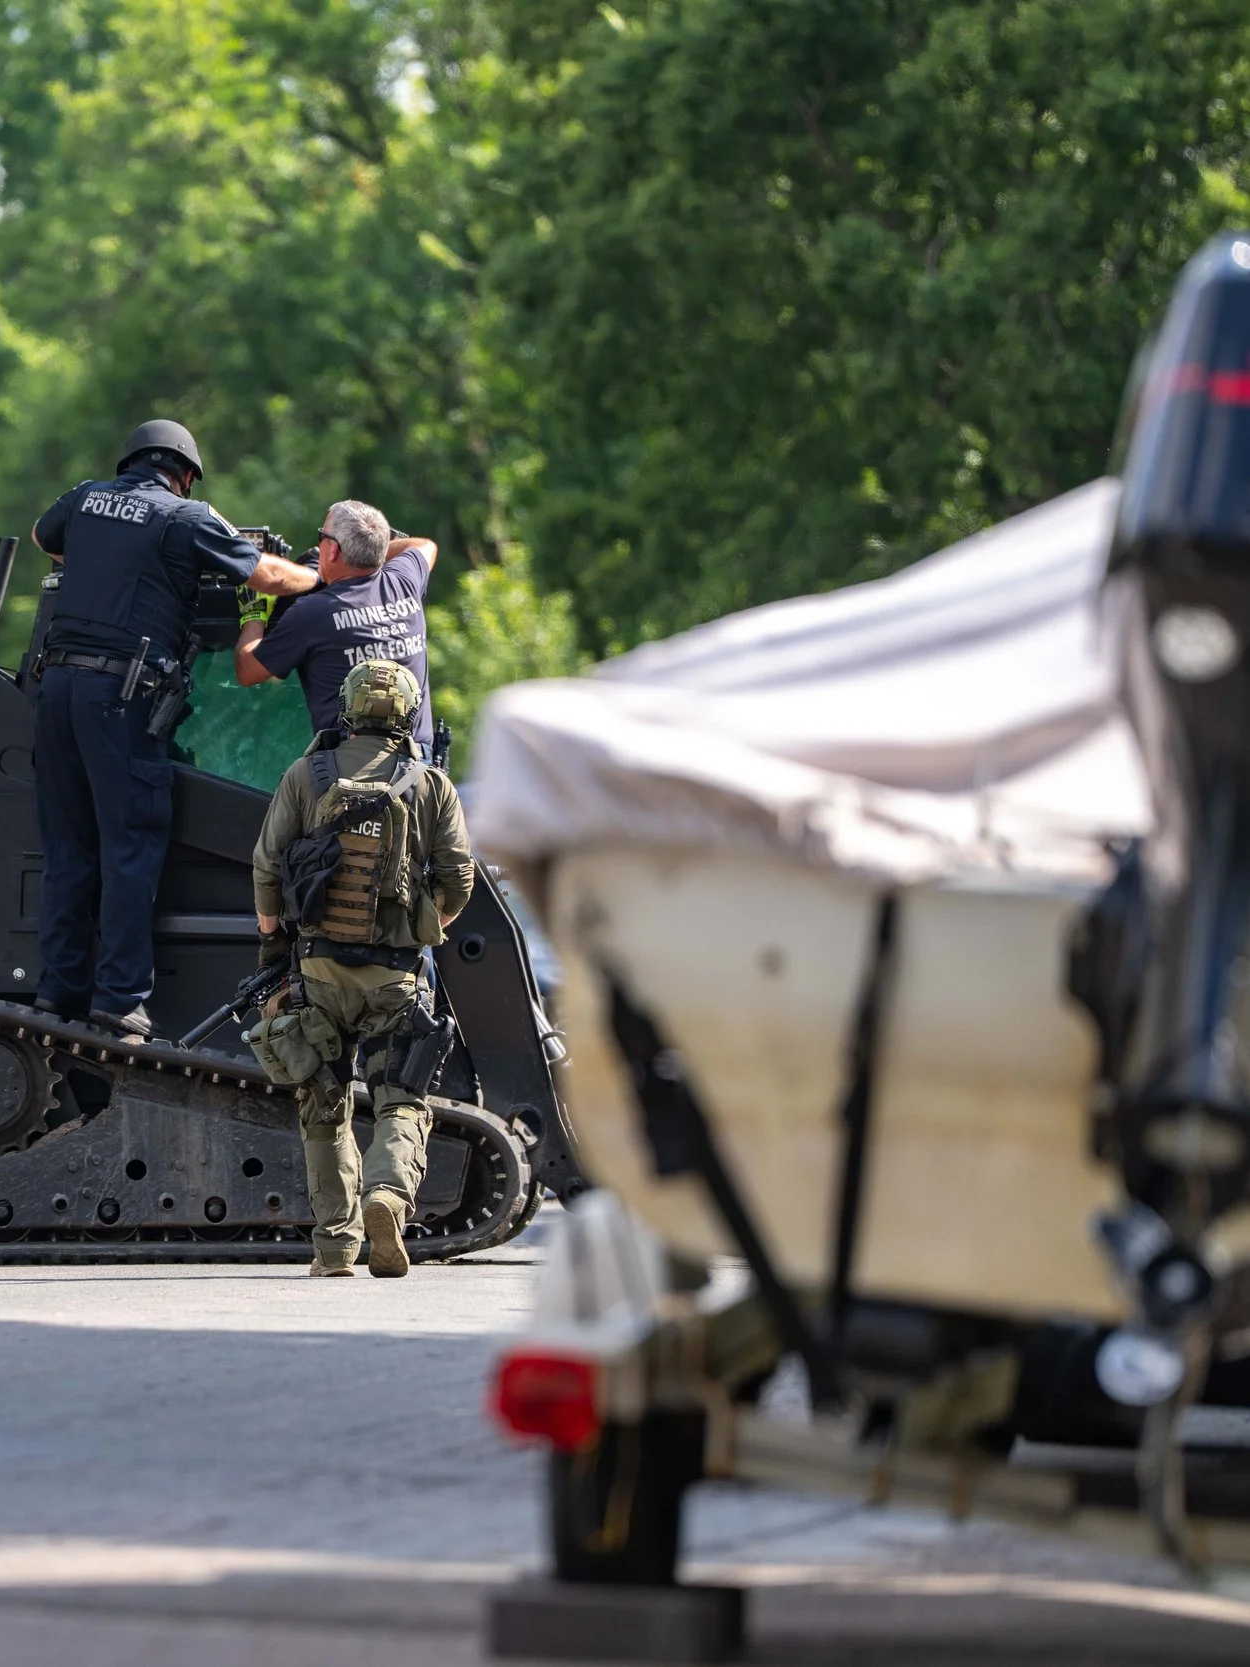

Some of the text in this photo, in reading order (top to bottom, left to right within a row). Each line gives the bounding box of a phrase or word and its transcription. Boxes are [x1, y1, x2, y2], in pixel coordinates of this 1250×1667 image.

[81, 497, 148, 524] POLICE
[87, 491, 149, 510] SOUTH ST. PAUL
[332, 596, 421, 631] MINNESOTA
[371, 622, 409, 638] US&R
[344, 641, 387, 667] TASK
[387, 633, 423, 659] FORCE
